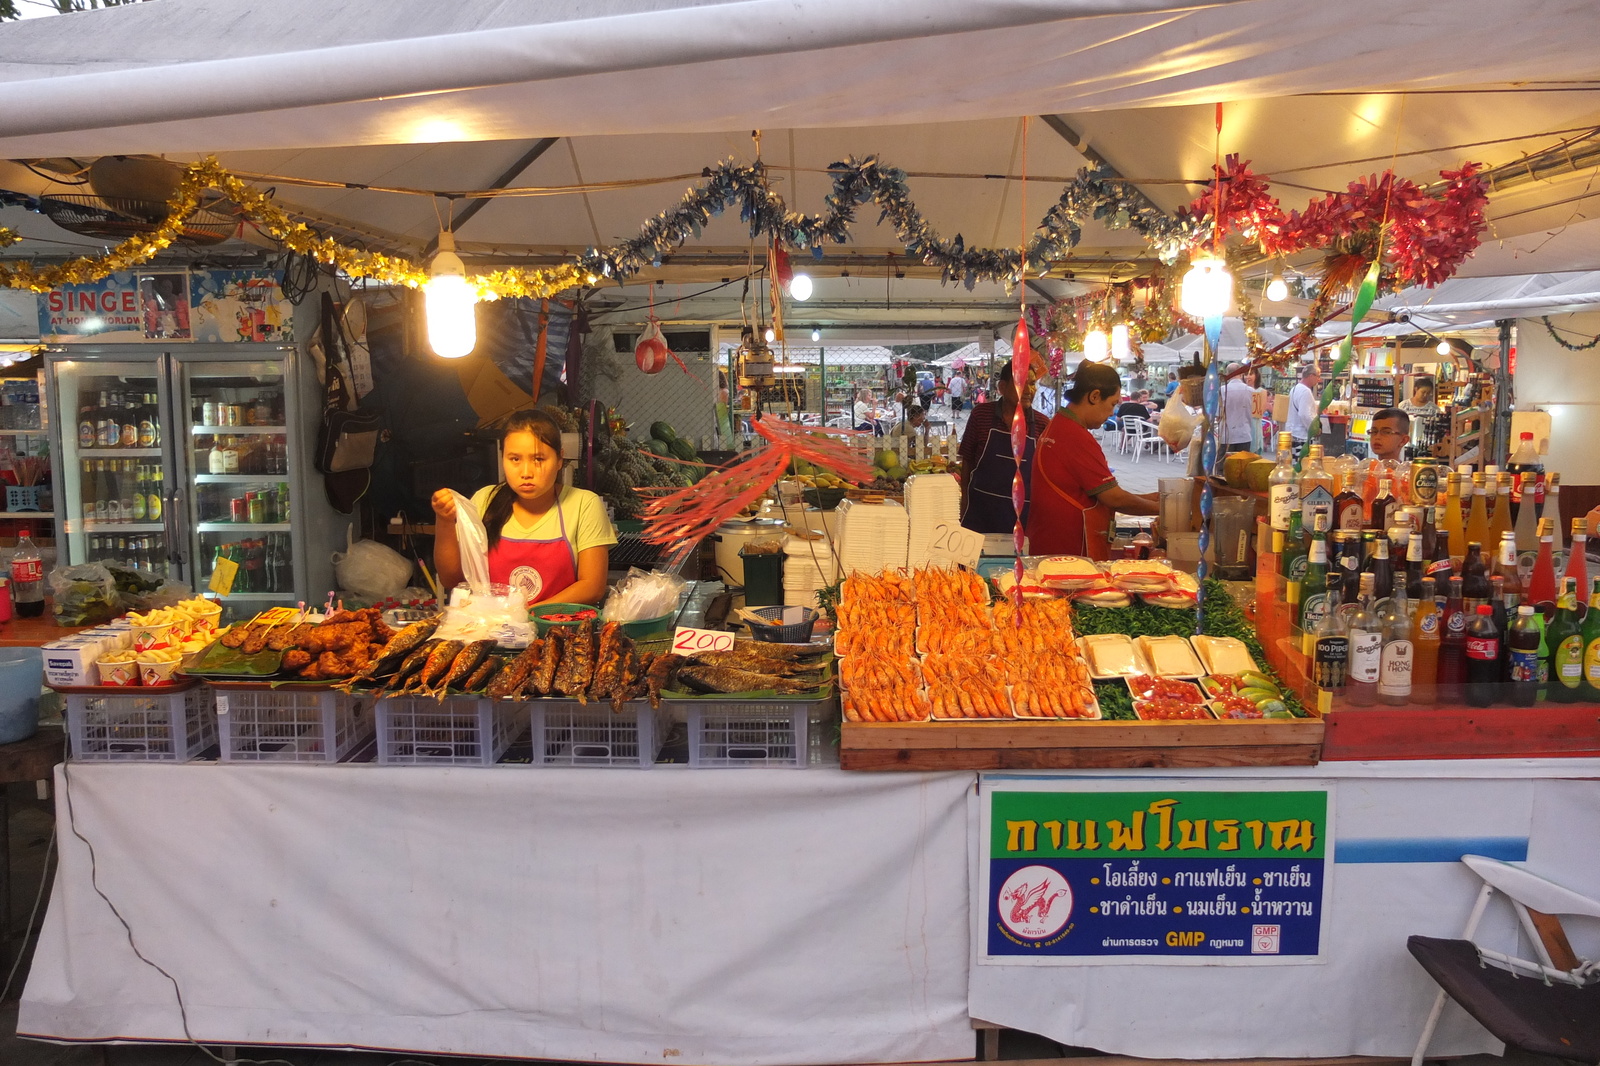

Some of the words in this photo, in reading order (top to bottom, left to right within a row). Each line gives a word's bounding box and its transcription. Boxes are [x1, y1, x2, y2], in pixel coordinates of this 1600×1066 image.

[49, 291, 143, 312] SINGE
[51, 317, 63, 325] AT
[1416, 480, 1437, 488] Chang
[933, 524, 976, 557] 200
[260, 609, 292, 622] 10
[675, 630, 731, 651] 200
[1006, 798, 1317, 852] กาแฟโบราณ
[1103, 860, 1157, 887] โอเลี้ยง
[1174, 865, 1247, 887] กาแฟเย็น
[1263, 865, 1311, 887] ชาเย็น
[1100, 893, 1167, 916] ชาดำเย็น
[1186, 893, 1237, 916] นมเย็น
[1251, 888, 1312, 916] น้ำหวาน
[1102, 936, 1159, 947] ผ่านการตรวจ
[1165, 931, 1205, 947] GMP
[1255, 927, 1277, 935] GMP
